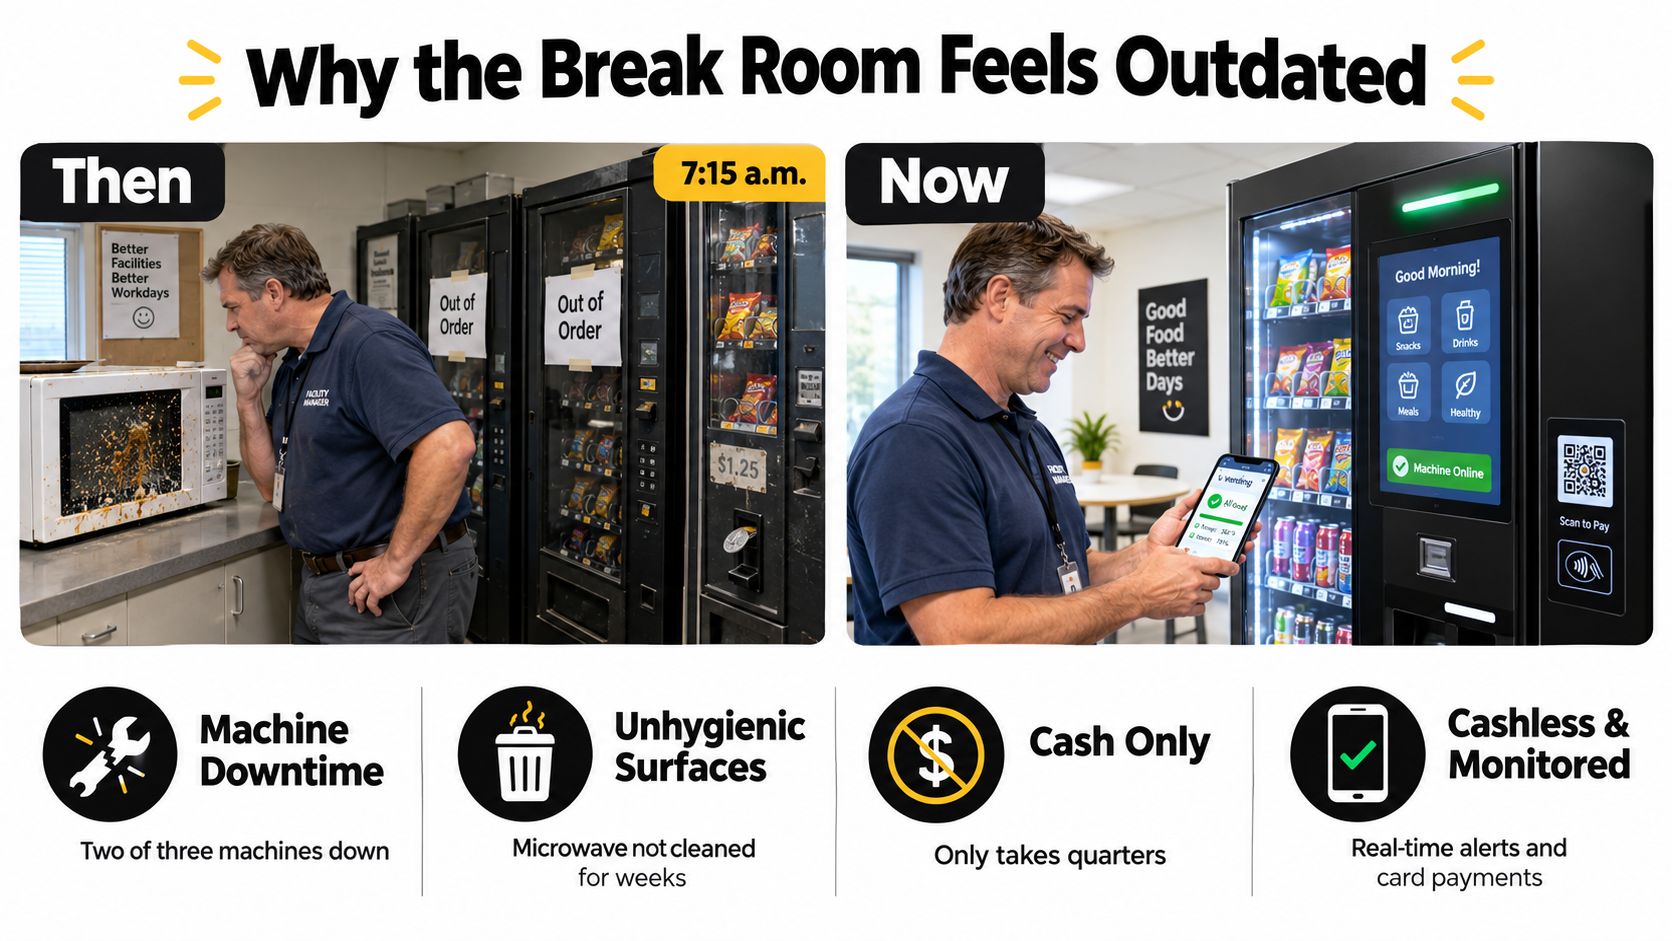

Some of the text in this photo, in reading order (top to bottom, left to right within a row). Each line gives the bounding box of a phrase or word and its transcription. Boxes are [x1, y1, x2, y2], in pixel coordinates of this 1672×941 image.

[112, 243, 148, 254] Better
[112, 257, 161, 269] Facilities
[1396, 259, 1480, 283] Good Morning!
[112, 272, 149, 283] Better
[112, 287, 169, 300] Workdays
[440, 293, 475, 311] Out of
[558, 290, 604, 313] Out of
[1145, 297, 1187, 321] Good
[440, 318, 473, 335] Order
[559, 320, 602, 339] Order
[1146, 322, 1185, 345] Food
[1396, 342, 1421, 350] Snacks
[1453, 338, 1478, 347] Drinks
[1146, 349, 1195, 368] Better
[1146, 372, 1184, 396] Days
[1399, 407, 1419, 416] Meals
[1451, 408, 1481, 419] Healthy
[717, 453, 759, 480] $1.25
[1414, 463, 1484, 478] Machine Online
[1560, 516, 1609, 533] Scan to Pay
